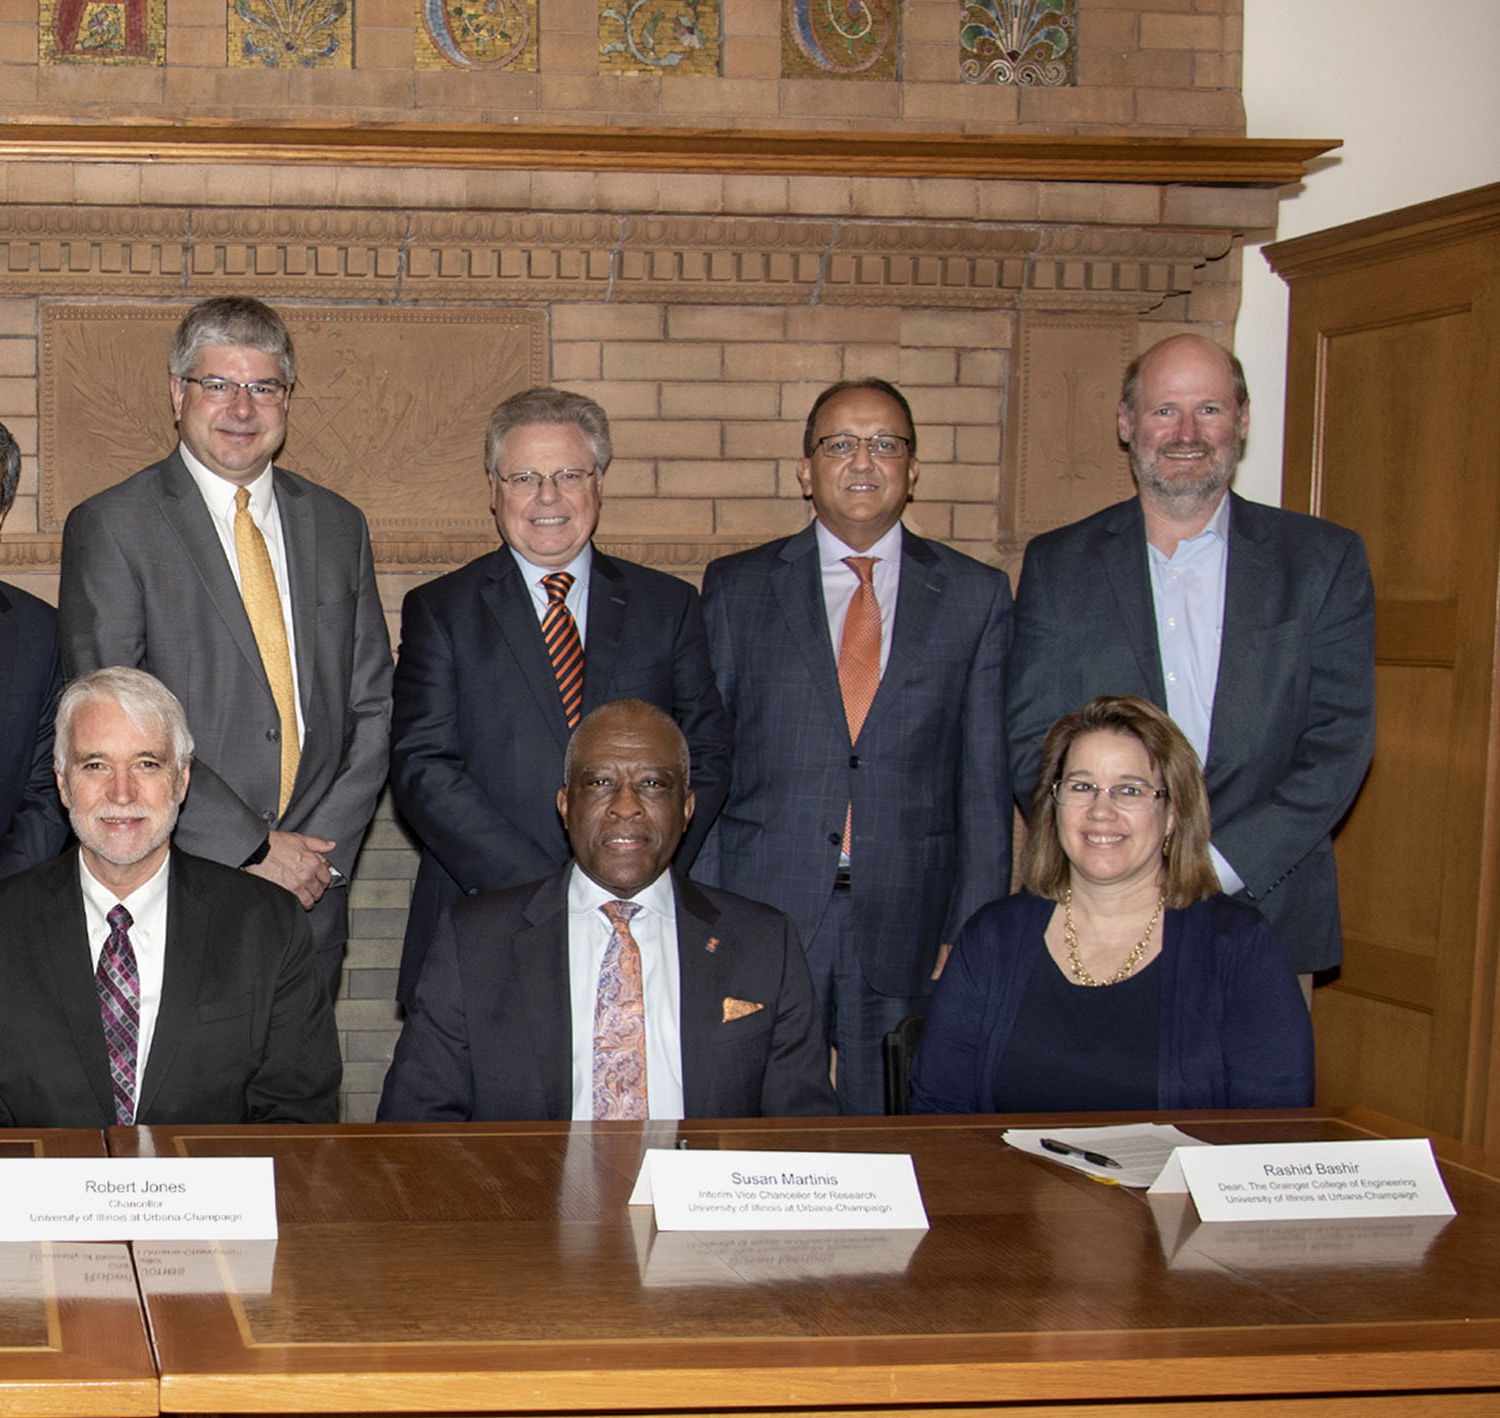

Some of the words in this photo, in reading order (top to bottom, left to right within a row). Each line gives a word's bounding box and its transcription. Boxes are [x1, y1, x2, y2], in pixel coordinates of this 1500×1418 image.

[1263, 1163, 1313, 1176] Rashid
[1315, 1162, 1360, 1176] Bashir
[85, 1179, 137, 1193] Robert
[141, 1179, 187, 1193] Jones
[731, 1172, 778, 1186] Susan
[781, 1172, 839, 1186] Martinis
[1248, 1182, 1268, 1191] The
[1269, 1181, 1310, 1192] Grainger
[1311, 1180, 1348, 1191] College
[1349, 1179, 1359, 1189] of
[1360, 1178, 1418, 1190] Engineering
[698, 1190, 733, 1200] Interim
[735, 1190, 757, 1200] Vice
[758, 1190, 812, 1200] Chancellor
[813, 1190, 827, 1200] for
[829, 1191, 877, 1200] Research
[1225, 1194, 1273, 1206] University
[1274, 1193, 1284, 1203] of
[1285, 1193, 1315, 1203] Illinois
[1316, 1192, 1327, 1202] at
[1328, 1190, 1420, 1203] Urbana-Champaign
[108, 1199, 163, 1209] Chancellor
[688, 1203, 737, 1214] University
[738, 1203, 749, 1213] of
[750, 1203, 782, 1213] Illinois
[784, 1203, 795, 1213] at
[796, 1203, 893, 1215] Urbana-Champaign
[29, 1213, 79, 1224] University
[82, 1213, 93, 1223] of
[95, 1213, 128, 1223] Illinois
[130, 1213, 141, 1223] at
[143, 1212, 243, 1224] Urbana-Champaign
